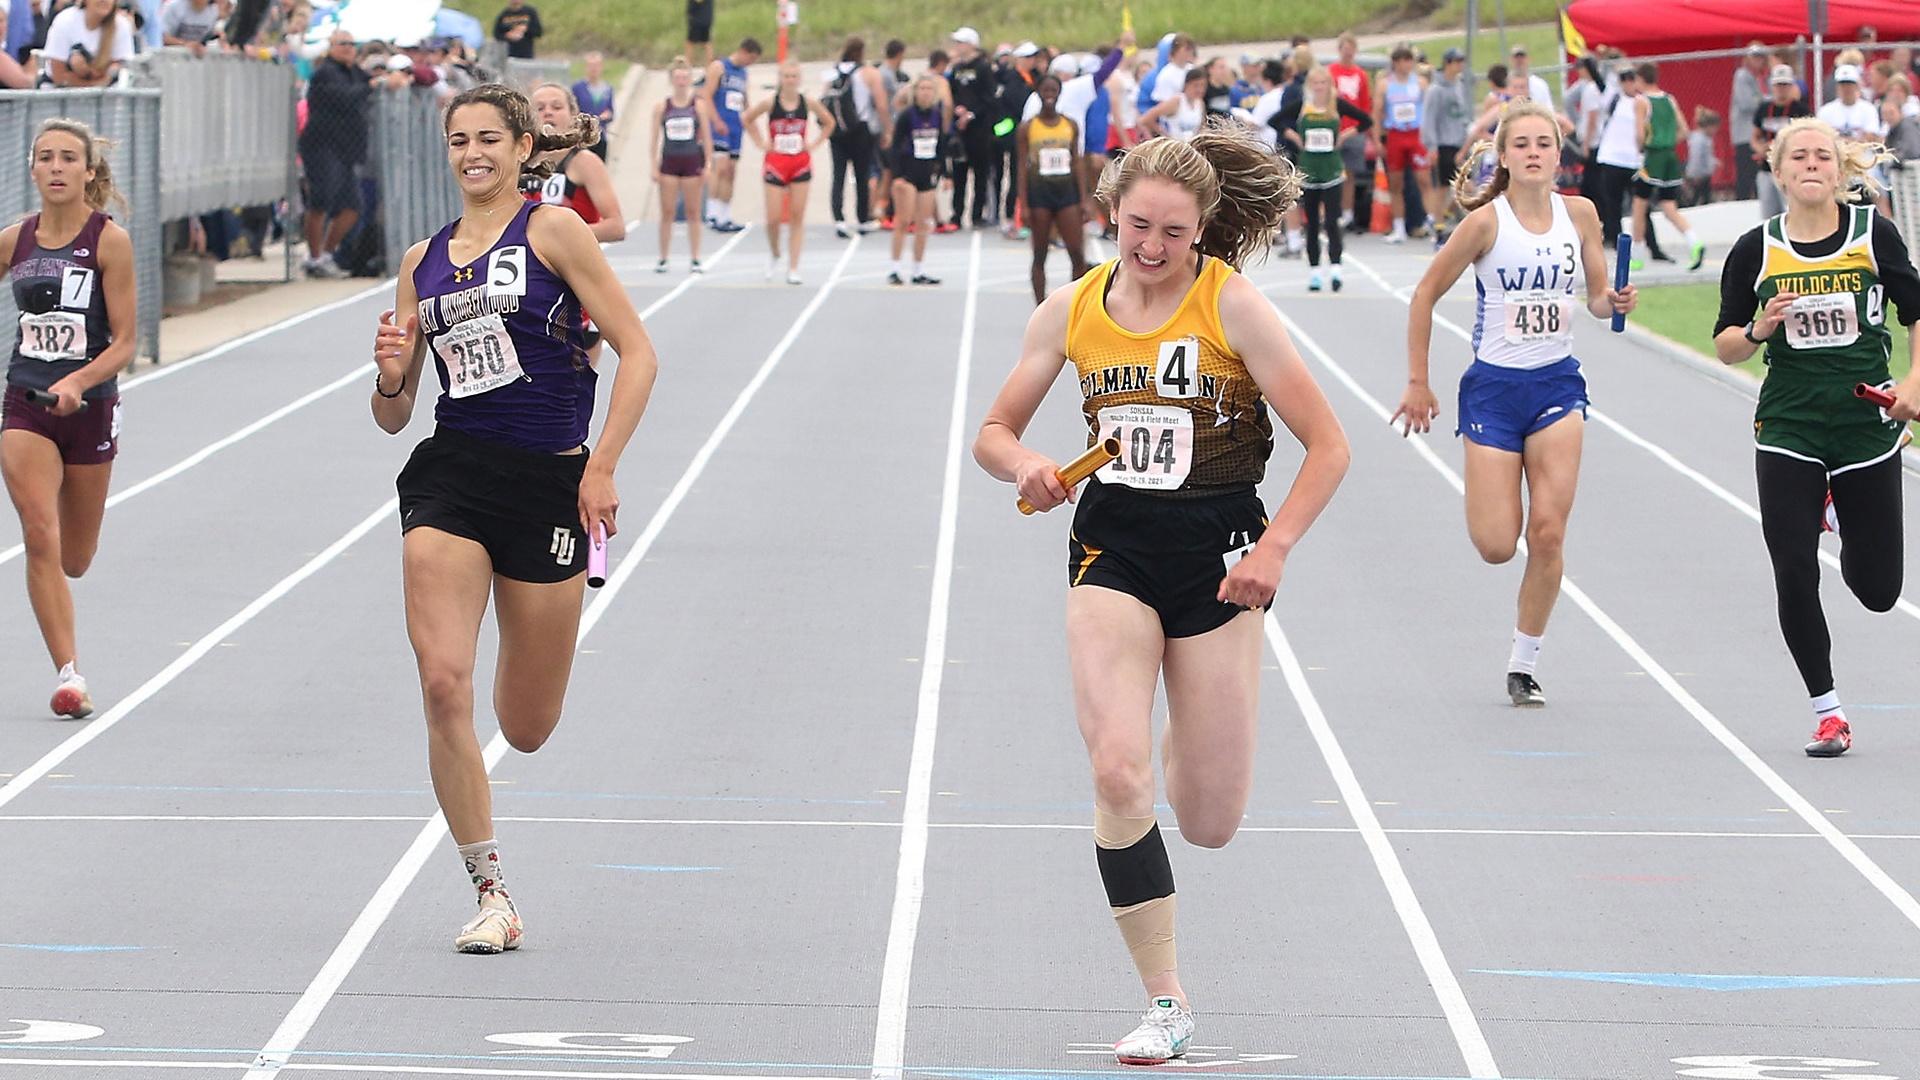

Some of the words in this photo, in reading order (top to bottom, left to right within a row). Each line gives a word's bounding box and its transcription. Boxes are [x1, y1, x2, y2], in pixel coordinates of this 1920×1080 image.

[547, 175, 560, 198] 6
[494, 248, 519, 287] 5
[1563, 242, 1576, 275] 3
[69, 269, 89, 301] 7
[1775, 272, 1862, 296] WILDCATS
[1870, 285, 1880, 318] 2
[1514, 303, 1560, 335] 438
[1794, 308, 1847, 338] 366
[30, 324, 75, 355] 382
[451, 334, 505, 384] 350
[1162, 345, 1190, 396] 4
[1111, 426, 1176, 474] 104
